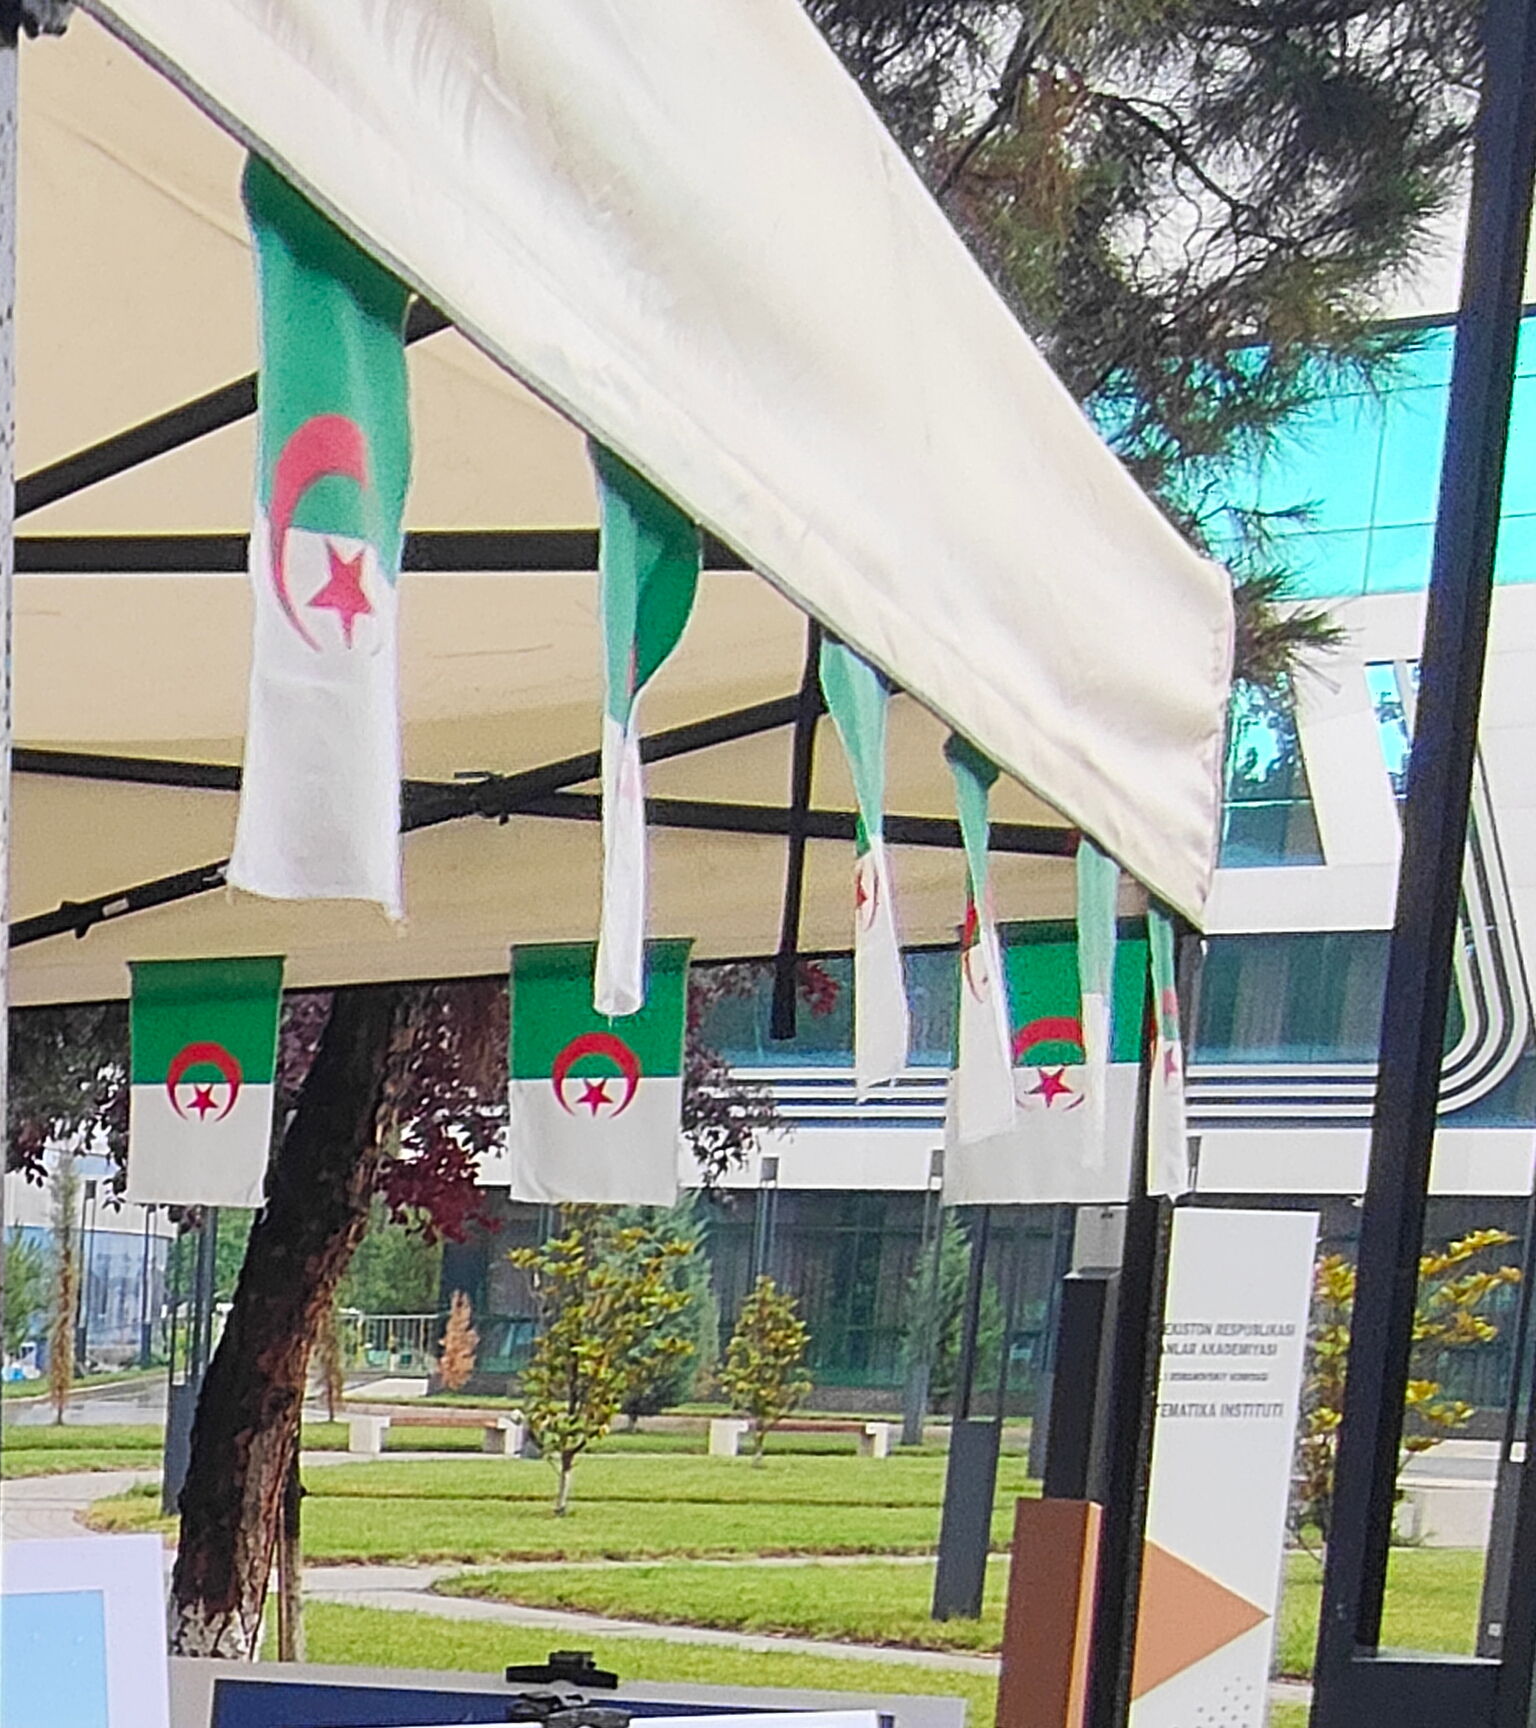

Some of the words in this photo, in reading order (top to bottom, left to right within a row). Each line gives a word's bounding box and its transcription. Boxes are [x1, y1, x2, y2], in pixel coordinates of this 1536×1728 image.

[1164, 1322, 1212, 1337] EKISTON
[1214, 1323, 1296, 1337] RESPUBLIKASI
[1199, 1343, 1278, 1356] AKADEMIYASI
[1219, 1403, 1284, 1418] INSTITUTI
